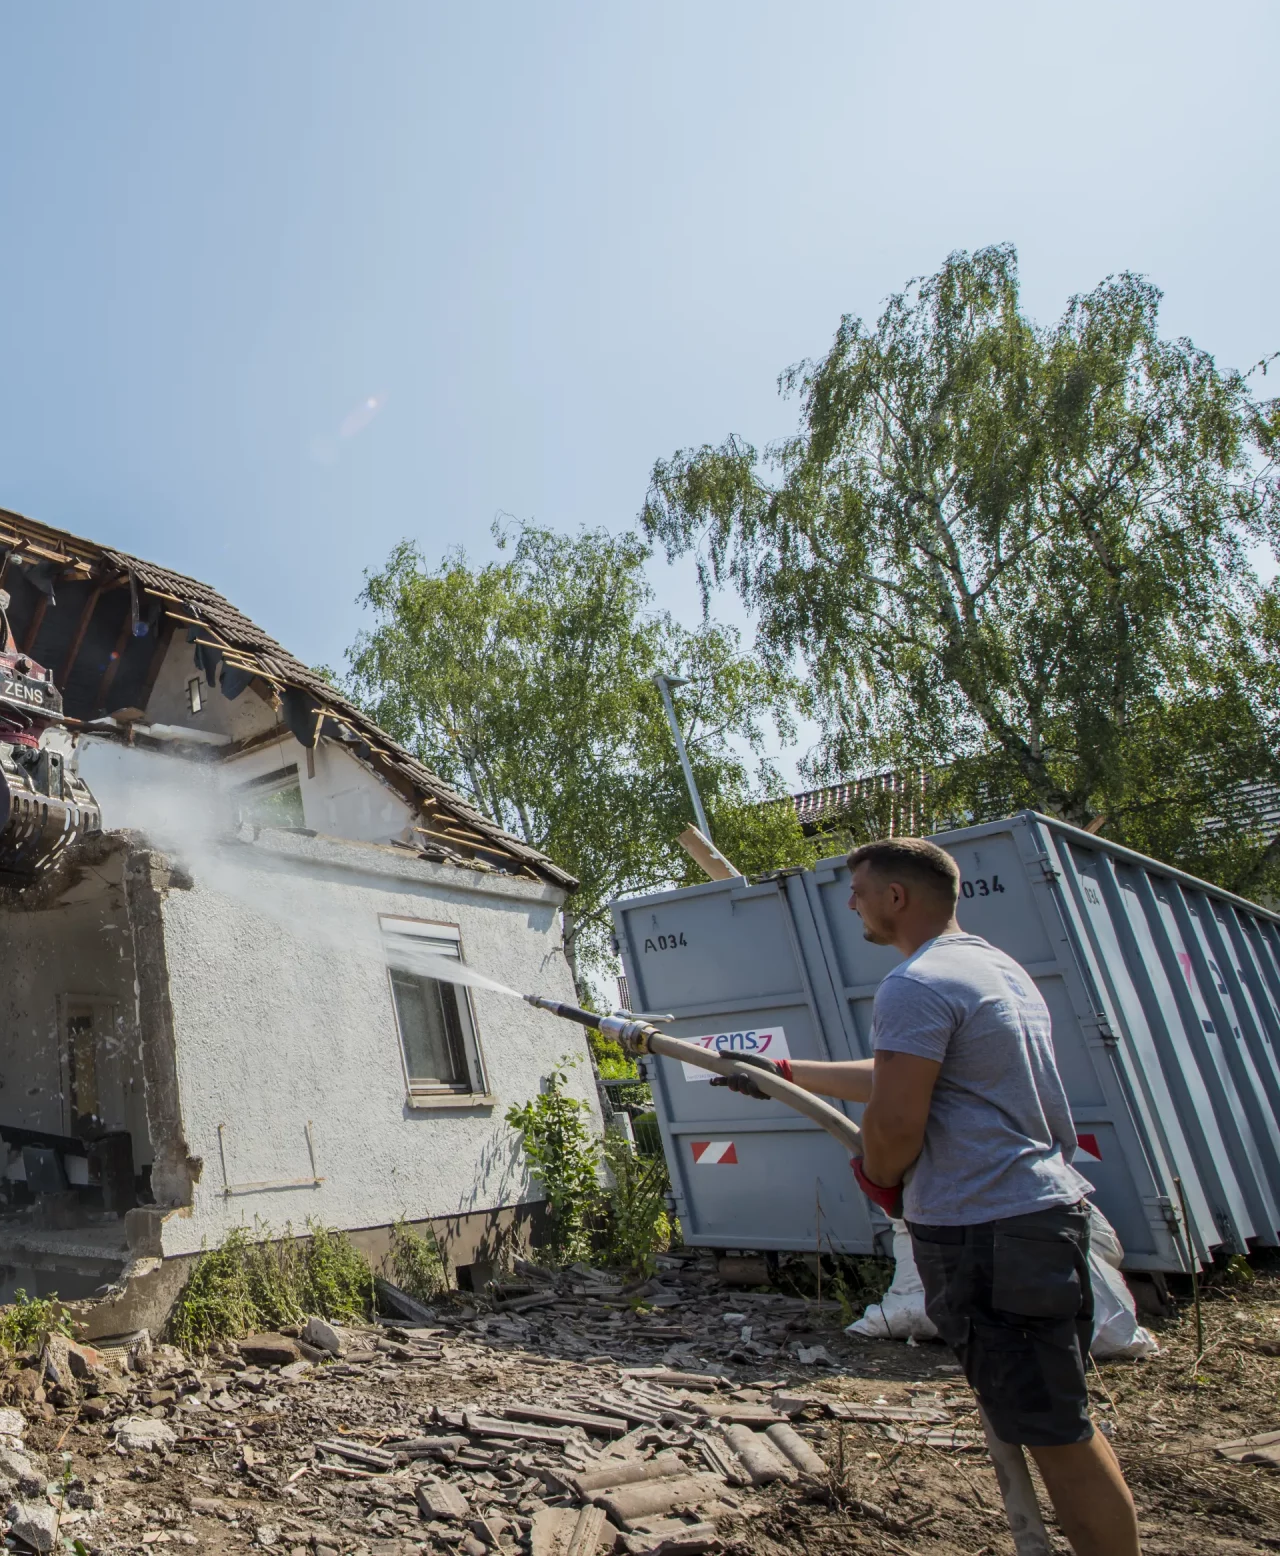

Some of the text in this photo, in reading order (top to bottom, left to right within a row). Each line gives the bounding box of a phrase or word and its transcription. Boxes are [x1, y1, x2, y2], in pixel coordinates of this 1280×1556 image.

[4, 680, 43, 704] ZENS
[958, 875, 1005, 899] 034
[645, 932, 688, 954] A034
